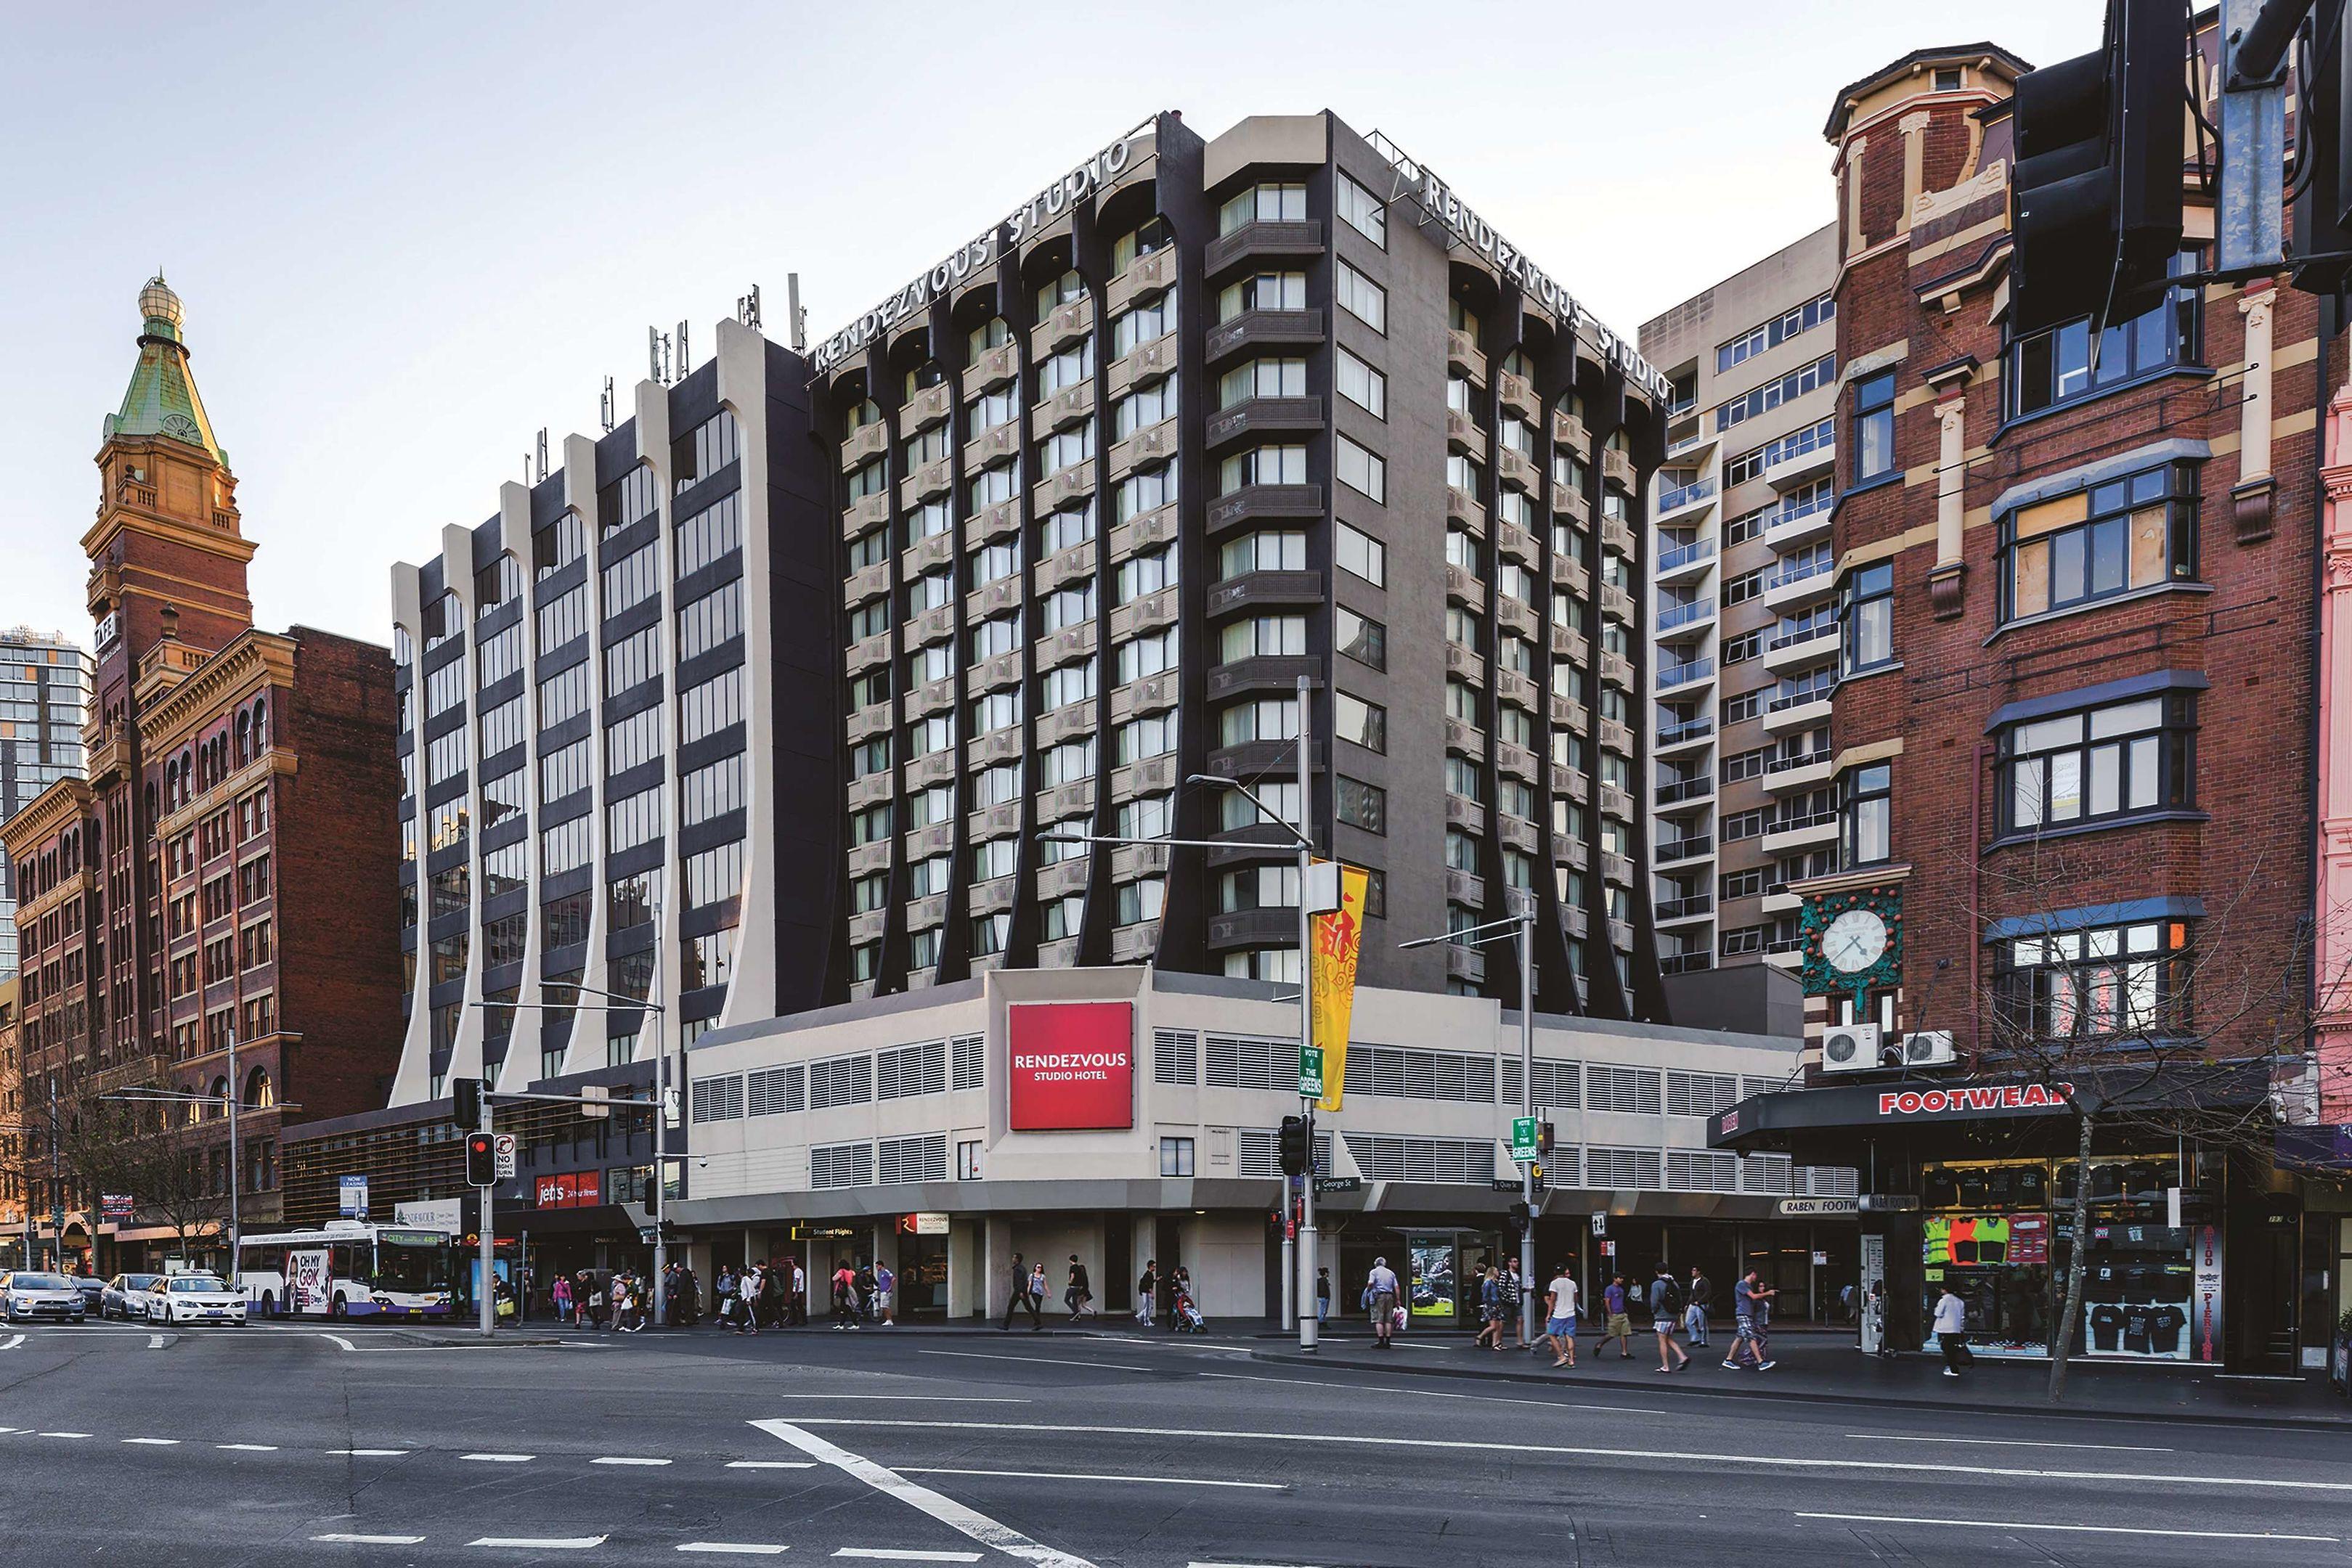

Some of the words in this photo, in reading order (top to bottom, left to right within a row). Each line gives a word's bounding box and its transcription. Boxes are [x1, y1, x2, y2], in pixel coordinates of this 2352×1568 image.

[814, 235, 990, 373] RENDEZVOUS
[1007, 137, 1131, 242] STUDIO
[1424, 176, 1584, 330] RENDEZVOUS
[1597, 322, 1669, 400] STUDIO
[94, 617, 112, 648] TAFE
[1015, 1053, 1126, 1068] RENDEZVOUS
[1305, 1049, 1318, 1058] VOTE
[1034, 1071, 1073, 1081] STUDIO
[1075, 1071, 1107, 1080] HOTEL
[1306, 1068, 1317, 1077] THE
[1300, 1076, 1322, 1093] GREENS
[1879, 1082, 2075, 1114] FOOTWEAR
[1513, 1146, 1537, 1159] GREENS
[1322, 1180, 1344, 1188] George
[1786, 1202, 1815, 1211] RABEN
[1822, 1200, 1858, 1210] FOOTW
[2203, 1225, 2215, 1267] ATTOO
[300, 1255, 310, 1267] OH
[311, 1254, 321, 1267] MY
[300, 1268, 320, 1286] GOK
